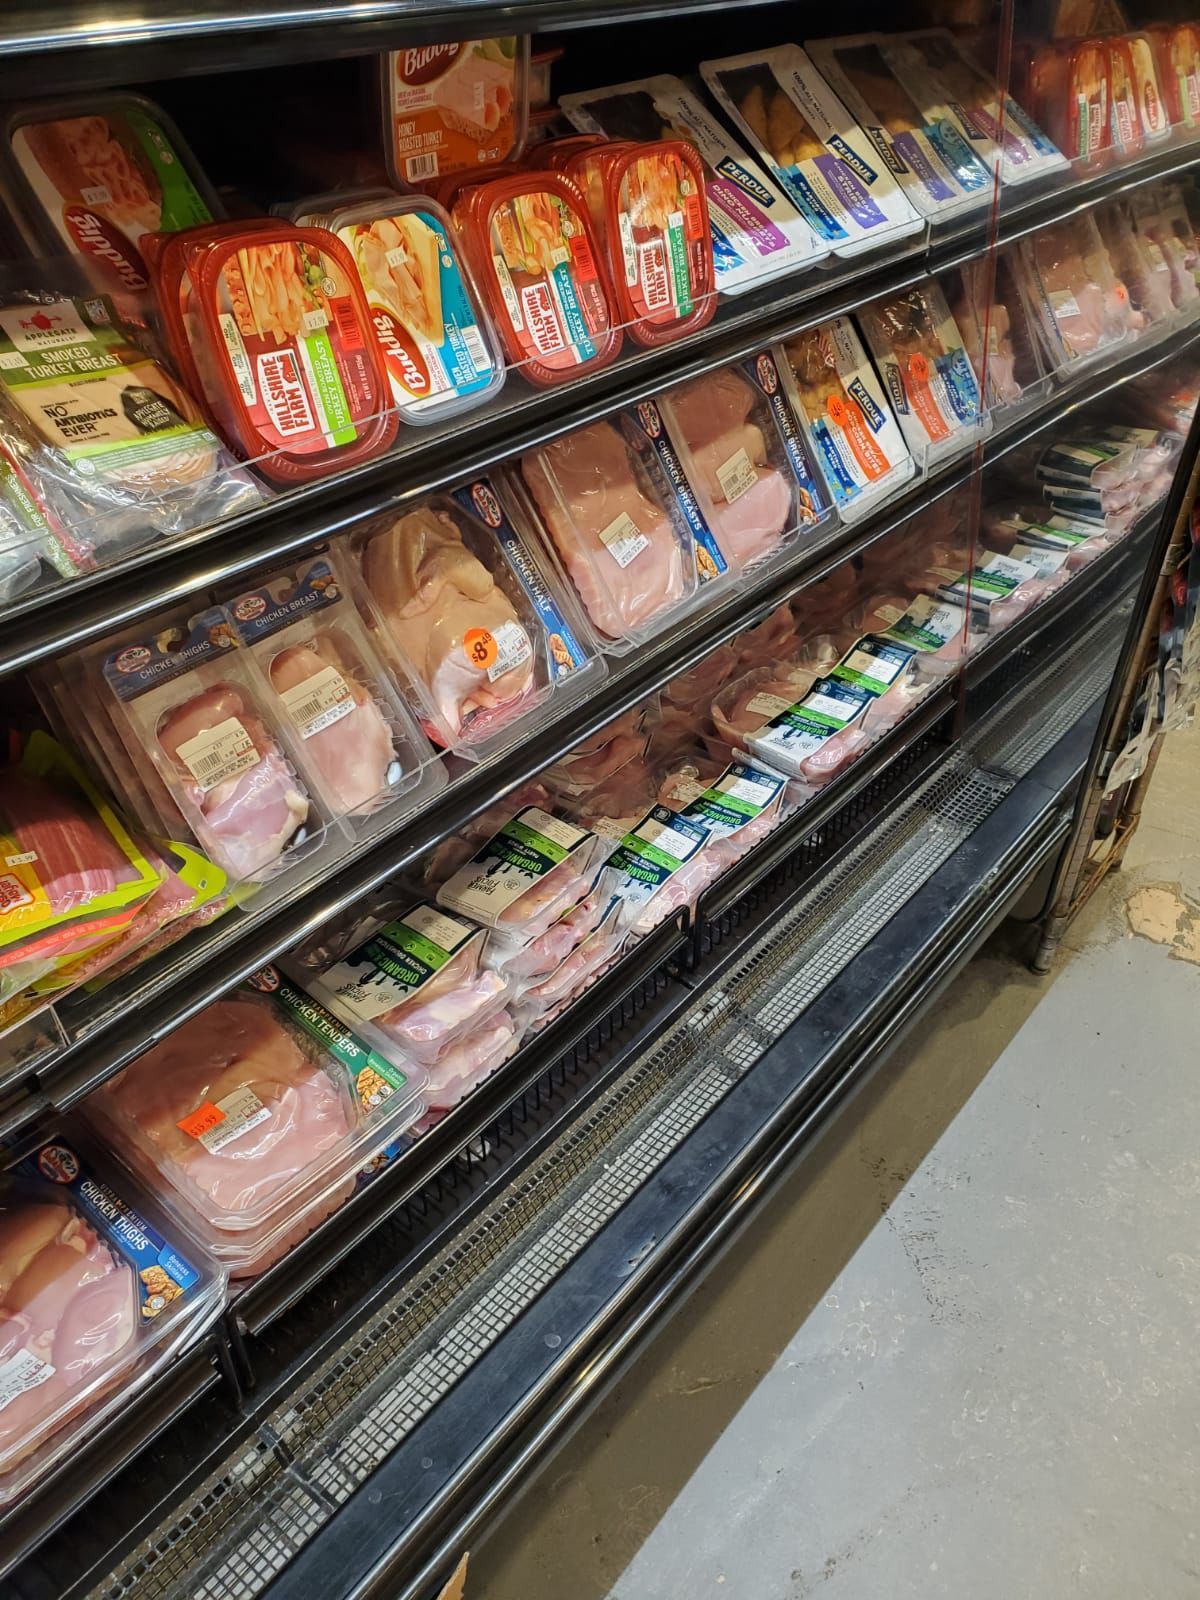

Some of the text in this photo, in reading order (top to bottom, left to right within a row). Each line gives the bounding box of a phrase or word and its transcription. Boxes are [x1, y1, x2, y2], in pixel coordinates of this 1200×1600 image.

[832, 138, 875, 182] PERDUE
[833, 161, 856, 191] CHICKEN
[723, 162, 772, 203] PERDUE
[837, 175, 864, 210] STRIPS
[712, 184, 737, 211] DINO
[736, 206, 776, 248] NUGGETS
[723, 187, 750, 216] CHICKEN
[750, 214, 776, 242] BREAST
[806, 190, 834, 225] ANTIBIOTICS
[66, 212, 148, 291] Buddig
[643, 246, 658, 306] HILLSHIRE
[654, 271, 667, 303] FARM
[675, 227, 693, 312] TURKEY BREAST
[559, 269, 578, 307] BREAST
[24, 327, 77, 342] APPLEGATE
[444, 323, 462, 351] TURKEY
[525, 290, 550, 351] HILLSHIRE
[544, 314, 561, 347] FARM
[573, 307, 593, 355] TURKEY
[24, 353, 124, 380] TURKEY BREAST
[40, 346, 91, 363] SMOKED
[373, 314, 426, 390] Buddig
[261, 356, 296, 431] HILLSHIRE
[315, 340, 346, 432] TURKEY BREAST
[315, 361, 334, 415] OVEN ROASTED
[852, 382, 883, 425] PERDUE
[43, 405, 68, 419] NO
[54, 407, 118, 428] ANTIBIOTICS
[286, 388, 310, 428] FARM
[60, 423, 97, 438] EVER
[773, 395, 807, 480] CHICKEN BREASTS
[846, 409, 880, 474] POPCORN BITES
[828, 446, 849, 481] ANTIBIOTICS
[7, 474, 44, 528] FOR FRESHNESS
[658, 440, 702, 531] CHICKEN BREASTS
[506, 540, 552, 613] CHICKEN HALF
[255, 591, 321, 629] CHICKEN BREAST
[179, 640, 211, 663] THIGHS
[708, 810, 742, 826] ORGANIC
[502, 853, 542, 873] ORGANIC
[525, 848, 540, 859] PARTY
[639, 858, 660, 872] CHICKEN
[467, 880, 496, 896] FARMER
[475, 874, 501, 889] FOCUS
[624, 863, 660, 883] ORGANIC
[380, 957, 420, 984] ORGANIC
[405, 957, 428, 975] CHICKEN
[335, 988, 366, 1003] FARMER
[344, 983, 372, 999] FOCUS
[280, 987, 360, 1057] CHICKEN TENDERS
[190, 1114, 217, 1136] $15.99
[80, 1181, 149, 1251] CHICKEN THIGHS
[119, 1204, 148, 1232] PREMIUM
[164, 1261, 184, 1282] Skinless
[168, 1254, 190, 1276] Boneless
